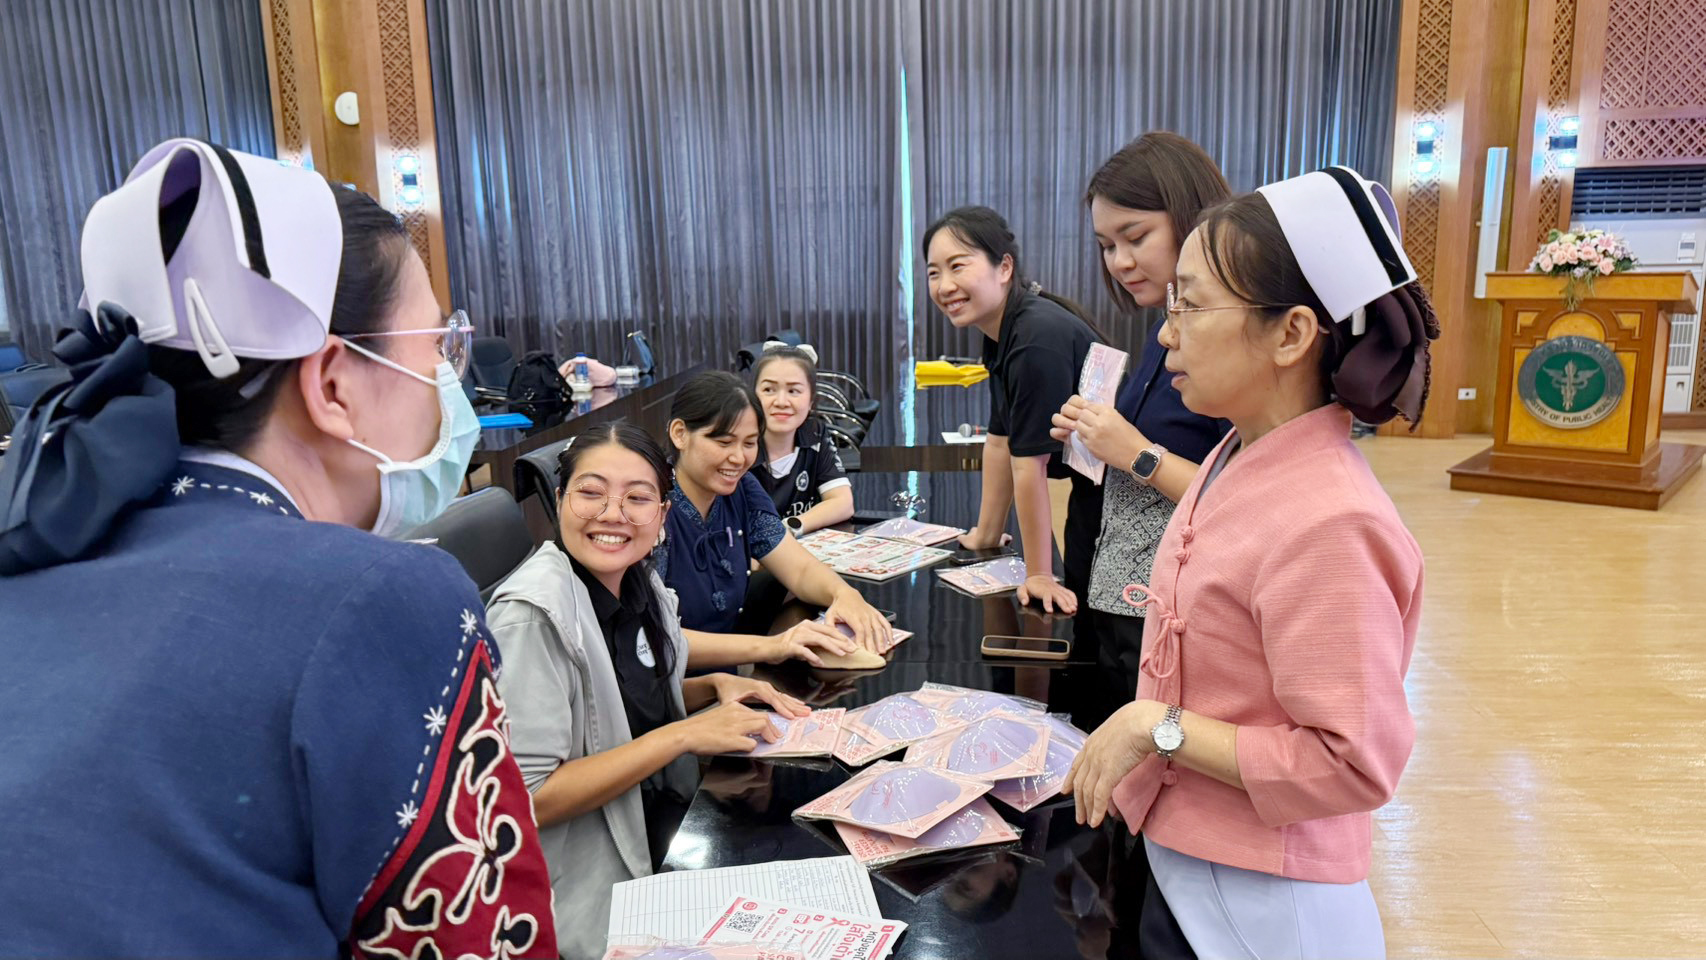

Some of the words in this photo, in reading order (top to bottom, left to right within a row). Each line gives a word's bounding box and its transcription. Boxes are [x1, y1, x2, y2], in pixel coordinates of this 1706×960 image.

[1549, 413, 1560, 421] OF
[1563, 413, 1592, 422] PUBLIC
[830, 923, 871, 960] ใส่ใจเต้า
